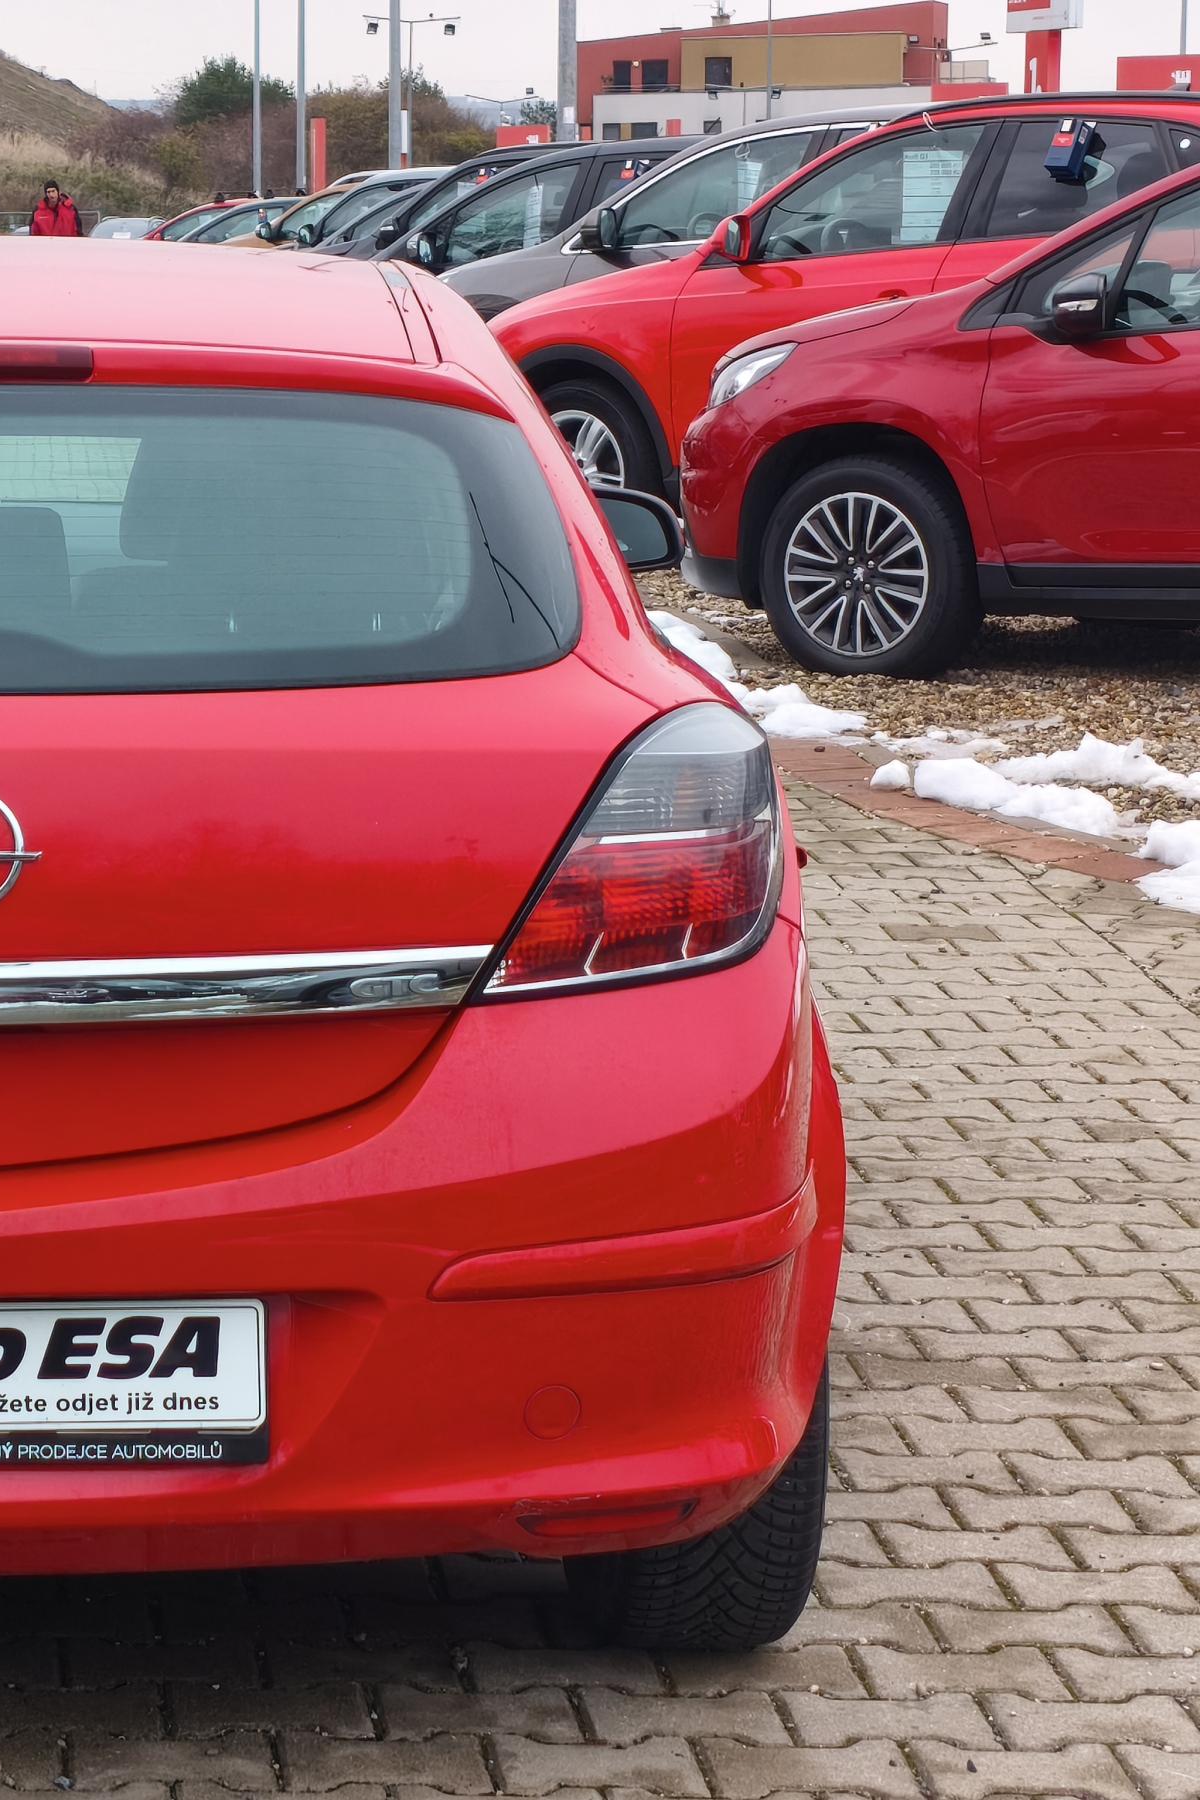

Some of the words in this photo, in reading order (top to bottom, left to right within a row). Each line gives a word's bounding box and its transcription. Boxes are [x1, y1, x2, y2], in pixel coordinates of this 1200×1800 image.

[350, 973, 438, 998] GTC
[36, 1316, 221, 1380] ESA
[56, 1393, 119, 1416] odjet
[126, 1392, 154, 1415] již
[163, 1392, 219, 1411] dnes
[18, 1444, 107, 1460] PRODEJCE
[112, 1441, 223, 1460] AUTOMOBILŮ
